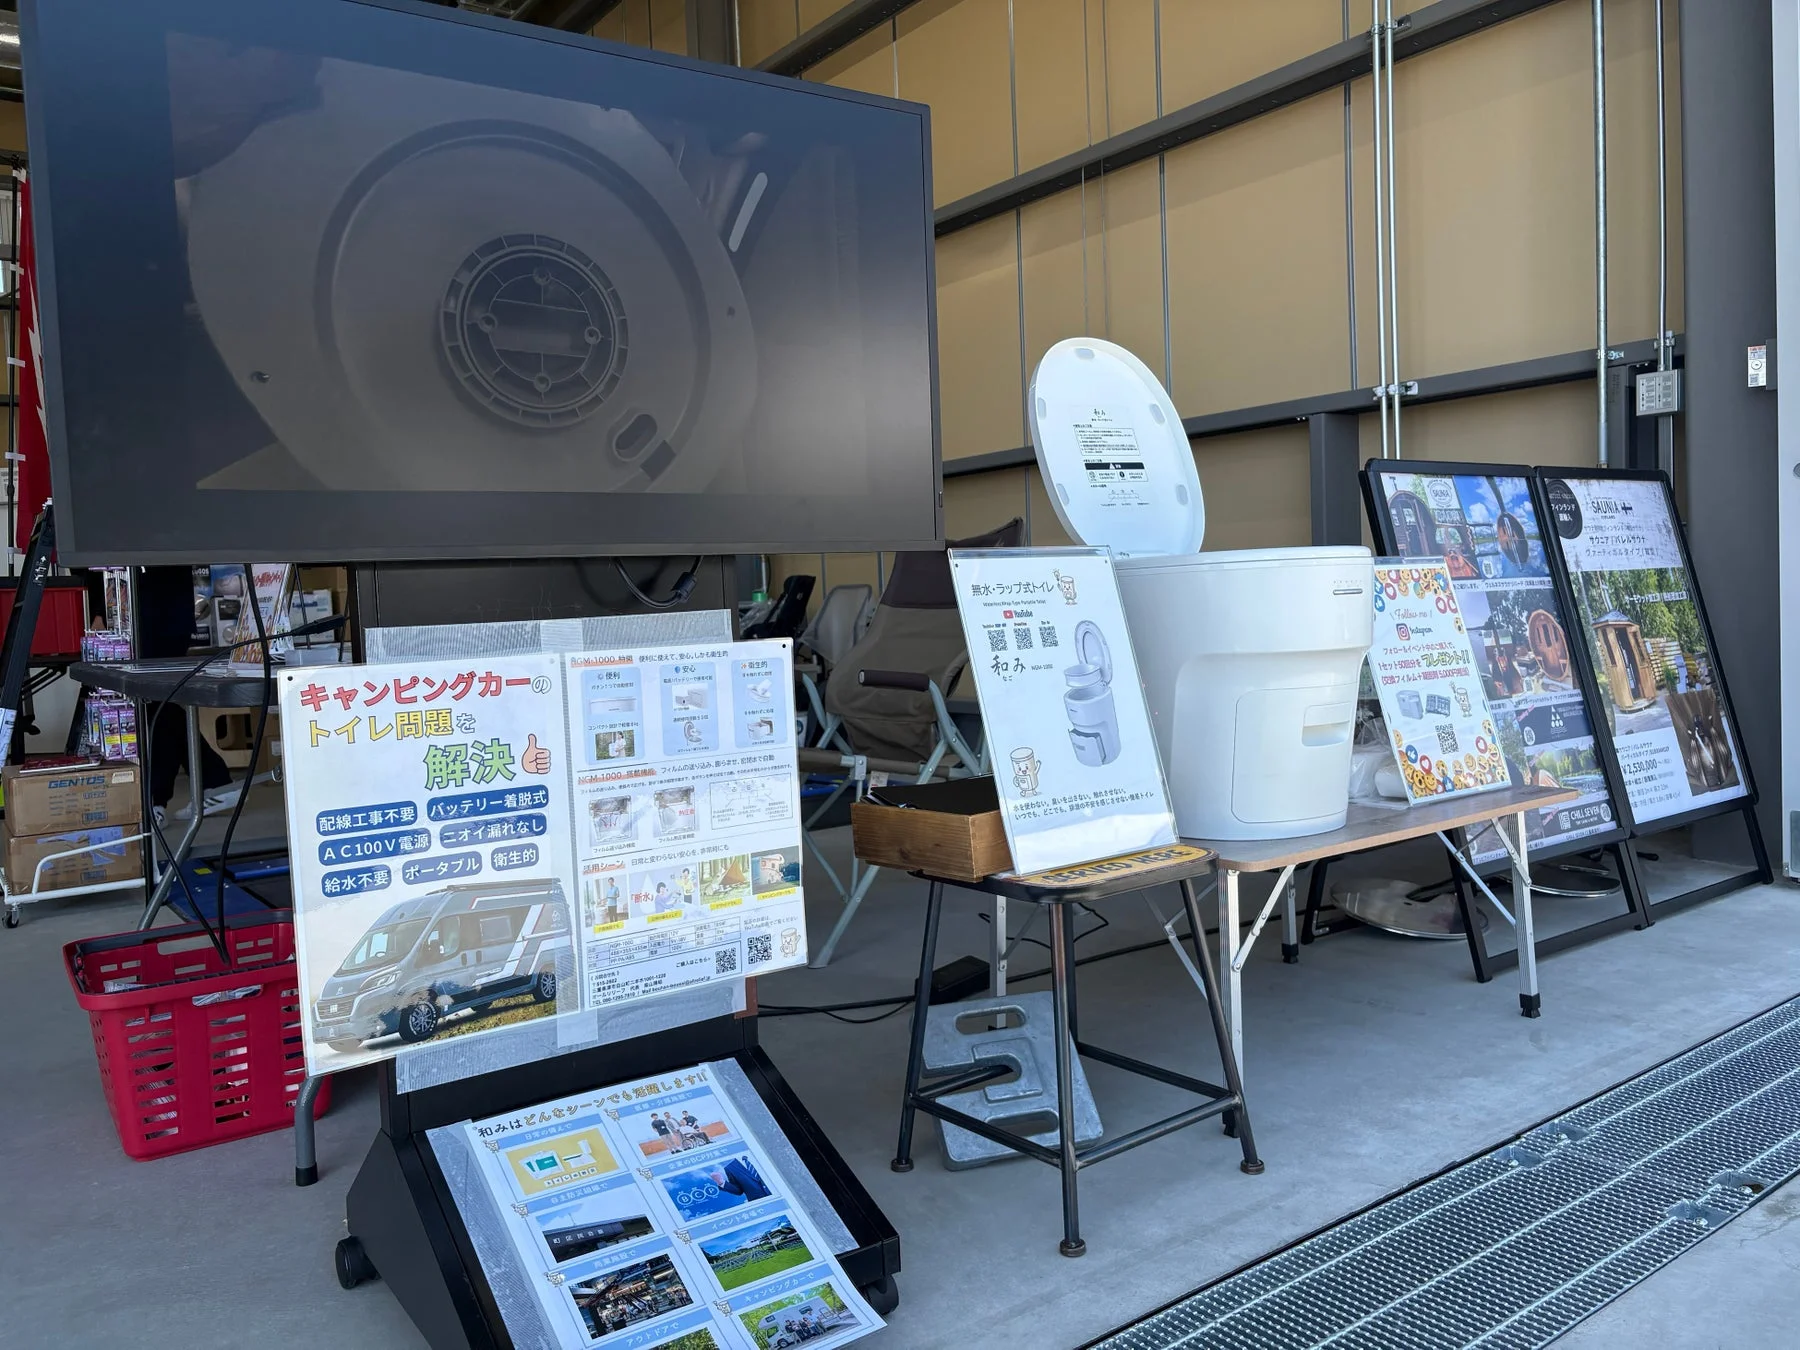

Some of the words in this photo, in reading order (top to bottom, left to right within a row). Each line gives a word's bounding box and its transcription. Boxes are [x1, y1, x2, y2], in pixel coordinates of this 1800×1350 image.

[1591, 501, 1620, 514] SAUNIA
[991, 655, 1026, 676] 和み
[300, 671, 551, 712] キャンピングカーの
[310, 708, 477, 748] トイレ問題を
[423, 738, 516, 792] 解決
[48, 775, 105, 789] GENTOS
[430, 789, 548, 817] バッテリー着脱式
[319, 806, 416, 833] 配線工事不要
[442, 818, 545, 845] ニオイ漏れなし
[404, 857, 480, 881] ポータブル
[493, 848, 537, 868] 衛生的
[1132, 848, 1193, 865] HERE
[324, 869, 390, 894] 給水不要
